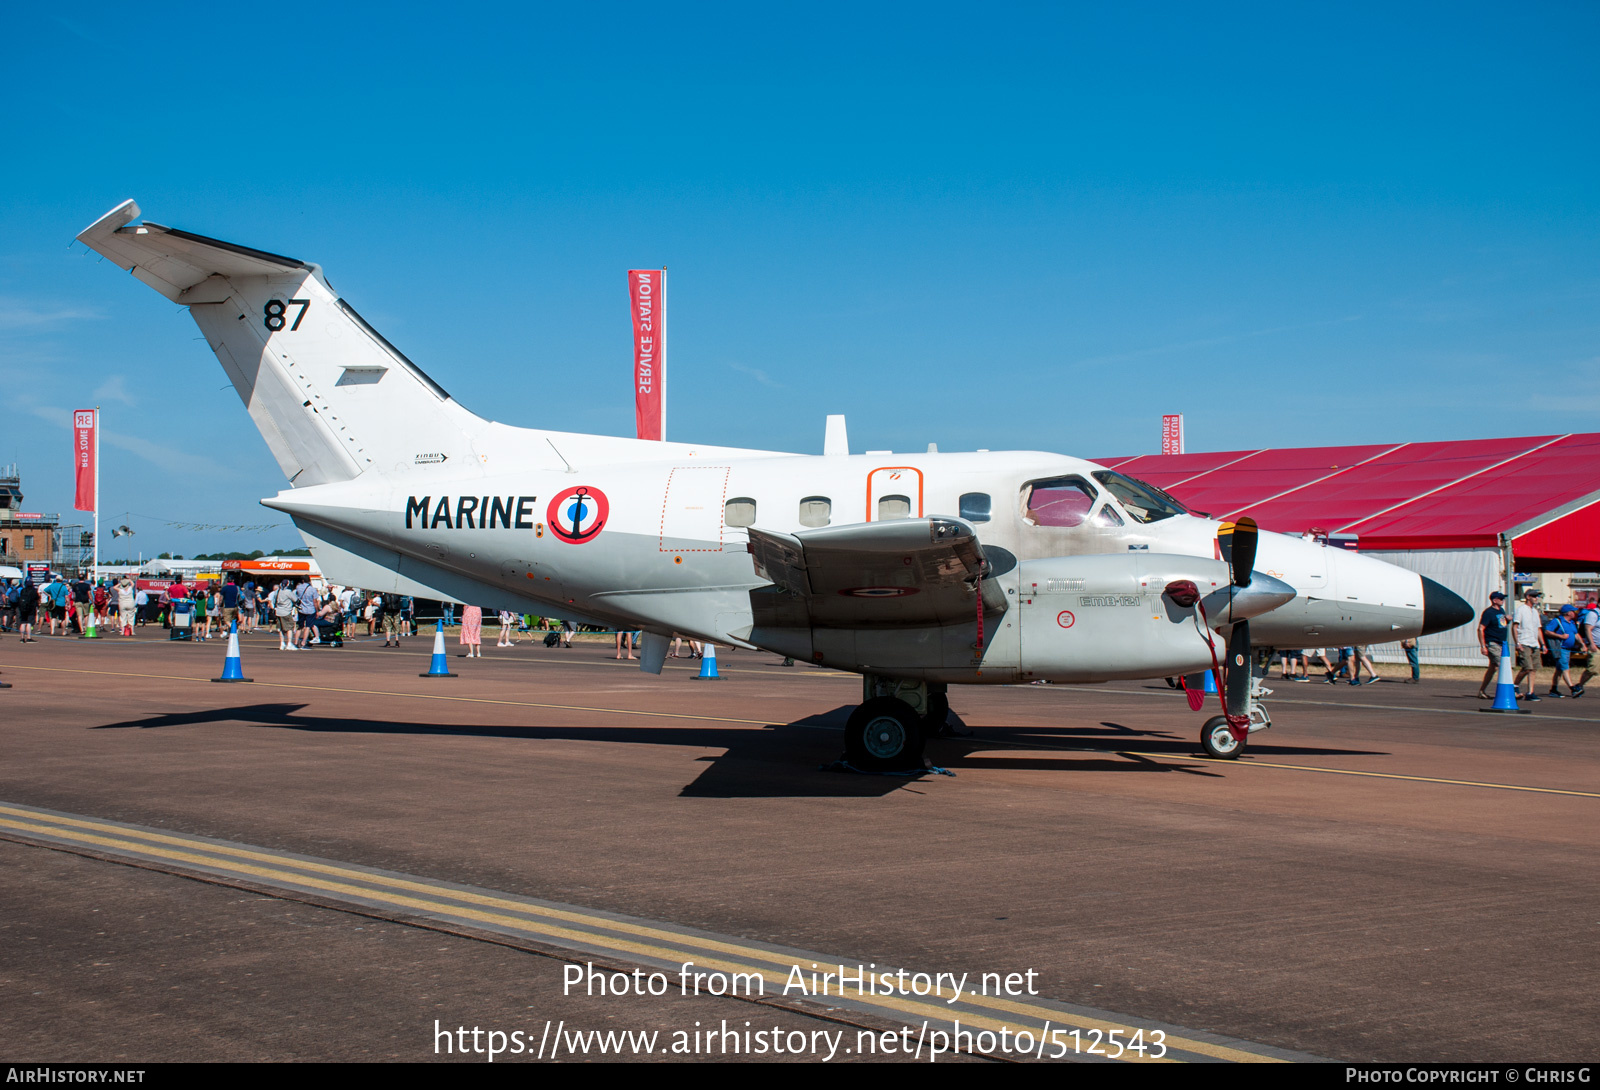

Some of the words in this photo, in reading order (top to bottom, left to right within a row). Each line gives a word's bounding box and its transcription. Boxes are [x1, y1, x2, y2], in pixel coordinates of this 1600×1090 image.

[263, 298, 310, 332] 87
[406, 496, 537, 530] MARINE
[272, 562, 293, 570] Coffee
